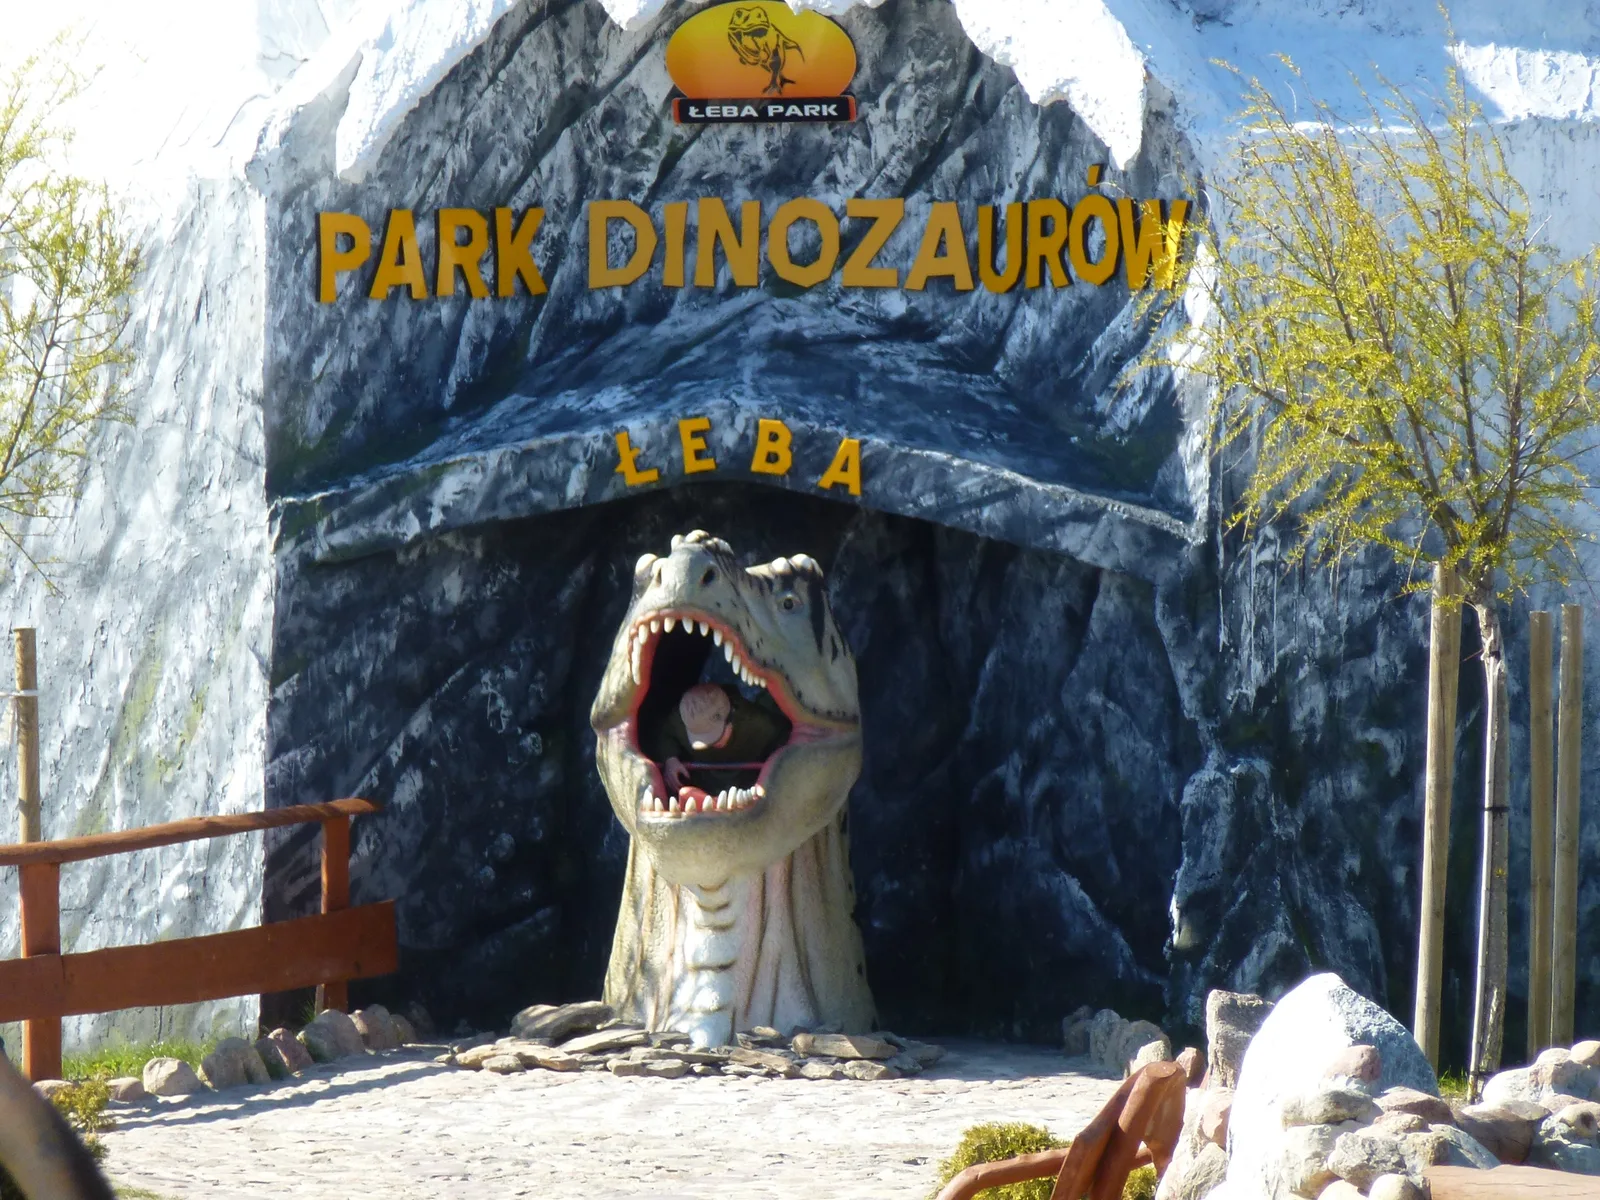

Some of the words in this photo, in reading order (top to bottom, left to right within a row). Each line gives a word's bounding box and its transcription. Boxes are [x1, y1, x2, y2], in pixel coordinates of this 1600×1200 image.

[688, 105, 759, 118] ŁEBA
[767, 104, 838, 117] PARK
[317, 206, 548, 304] PARK
[588, 165, 1188, 294] DINOZAURÓW
[615, 417, 861, 495] ŁEBA
